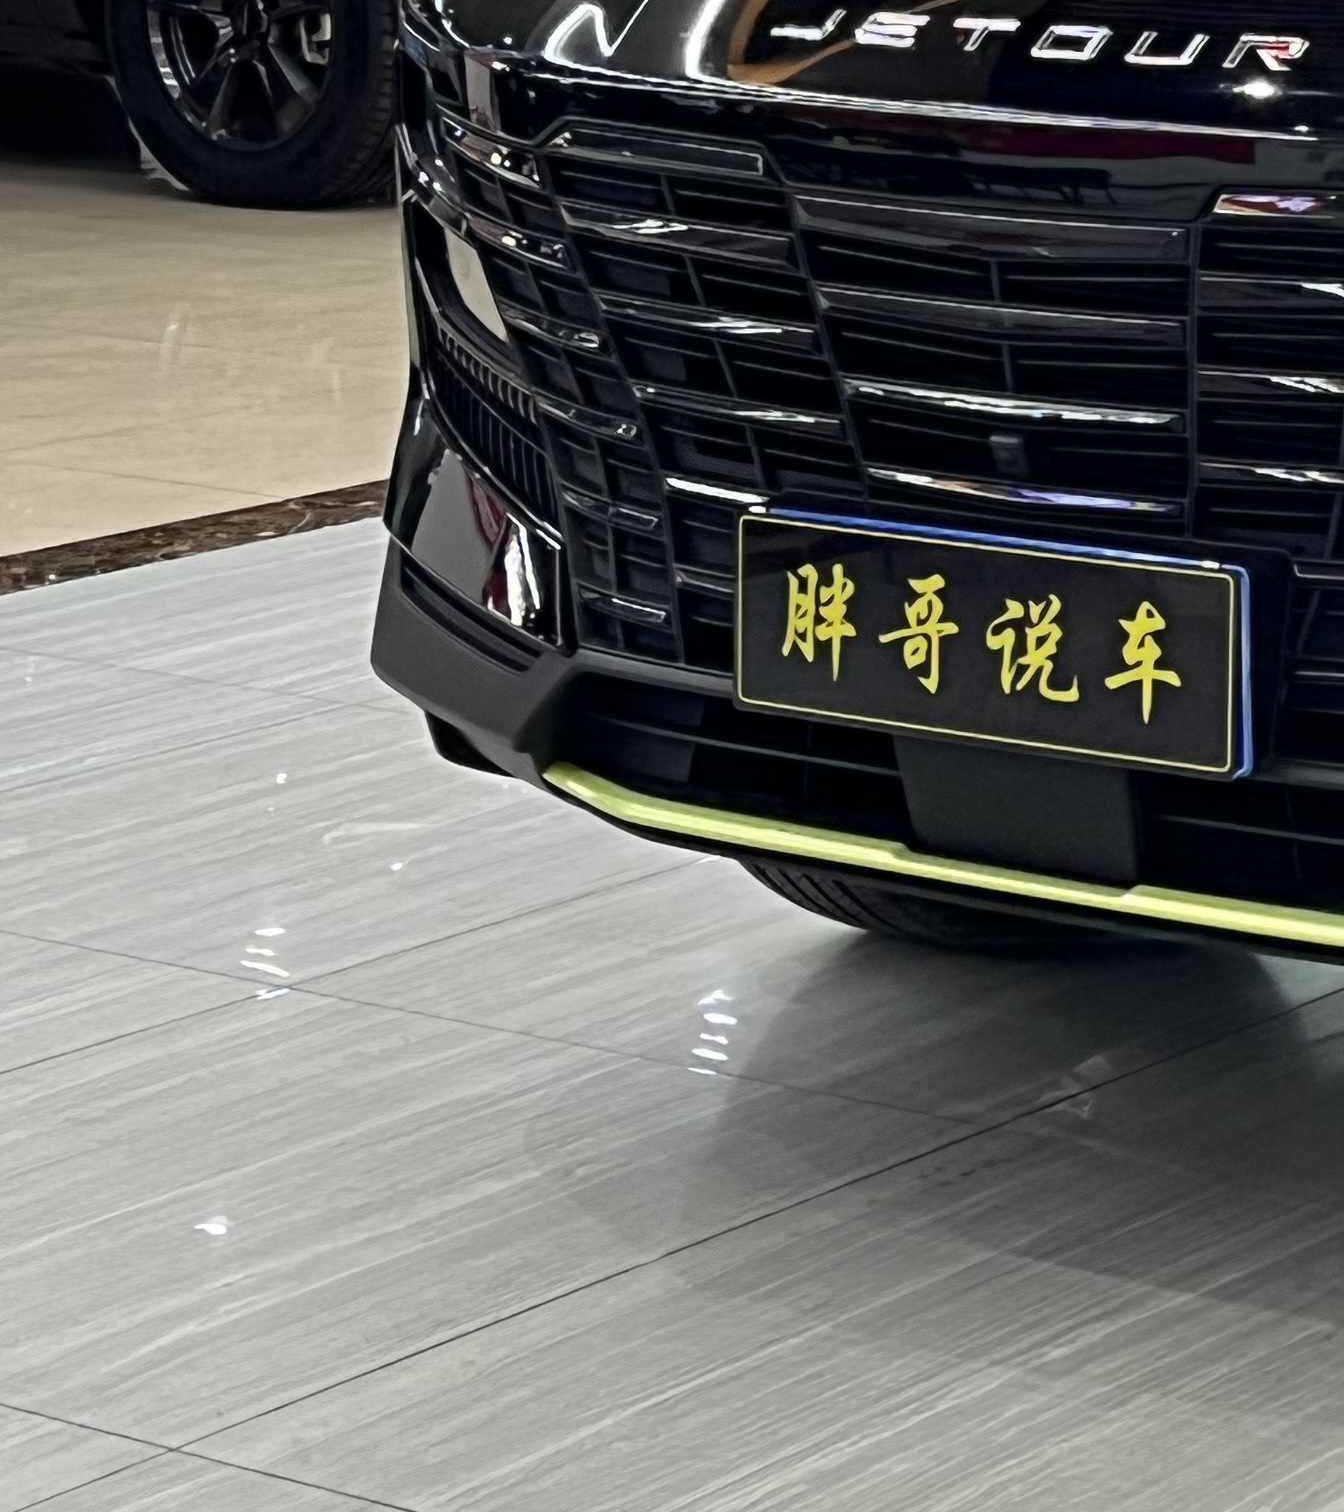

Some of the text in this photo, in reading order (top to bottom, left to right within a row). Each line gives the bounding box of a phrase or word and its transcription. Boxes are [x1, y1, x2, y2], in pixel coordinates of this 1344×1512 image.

[770, 8, 1310, 71] JETOUR
[781, 563, 1182, 725] 胖哥说车
